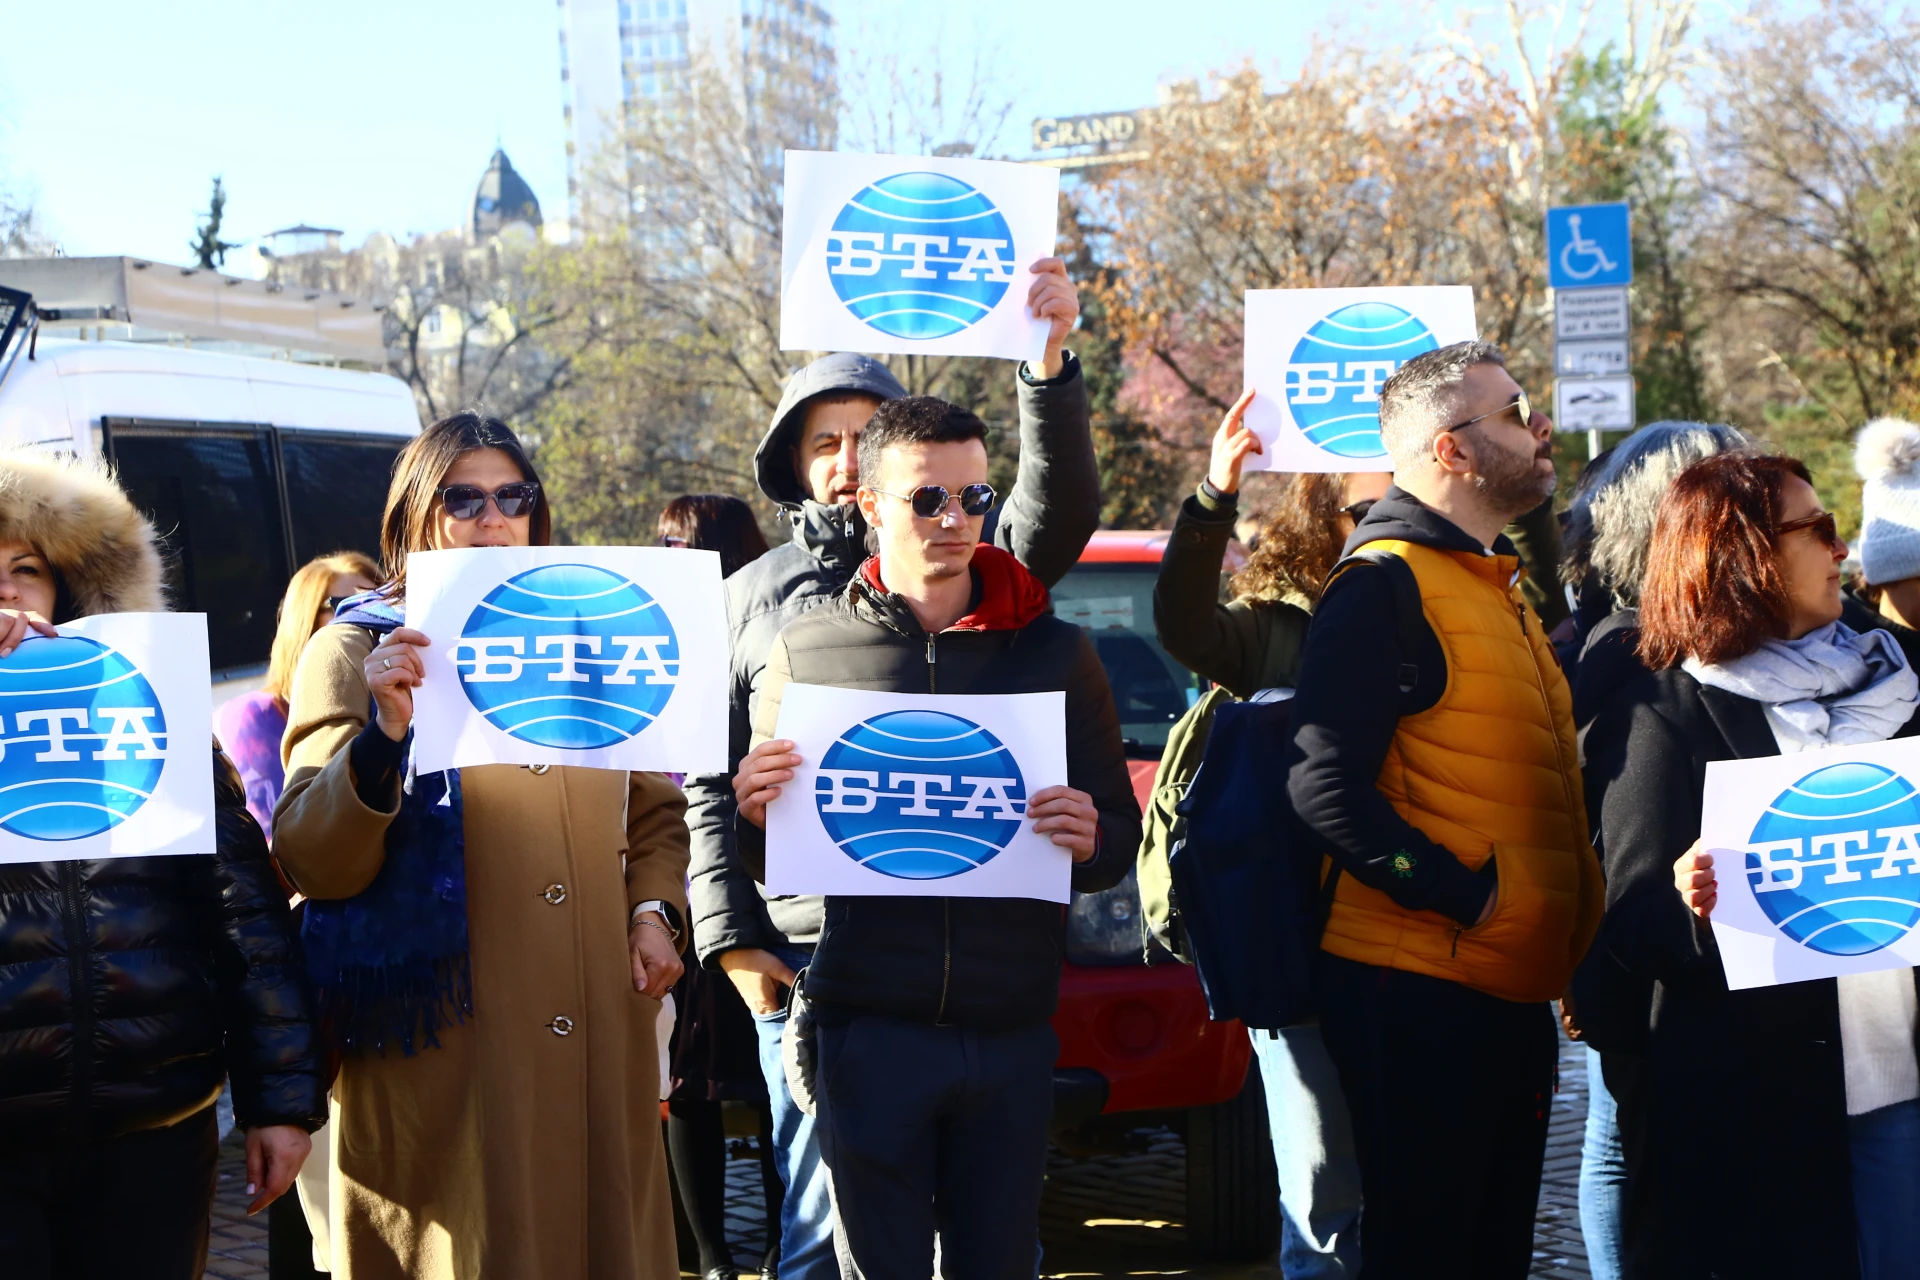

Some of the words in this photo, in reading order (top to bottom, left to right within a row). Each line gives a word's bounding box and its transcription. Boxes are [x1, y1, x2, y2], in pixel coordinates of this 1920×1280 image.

[1033, 115, 1136, 150] GRAND
[828, 230, 1013, 283] БТА
[1287, 359, 1409, 405] БТ
[457, 634, 679, 685] БТА
[0, 707, 167, 763] ТА
[815, 768, 1024, 821] БТА
[1746, 823, 1920, 894] БТА
